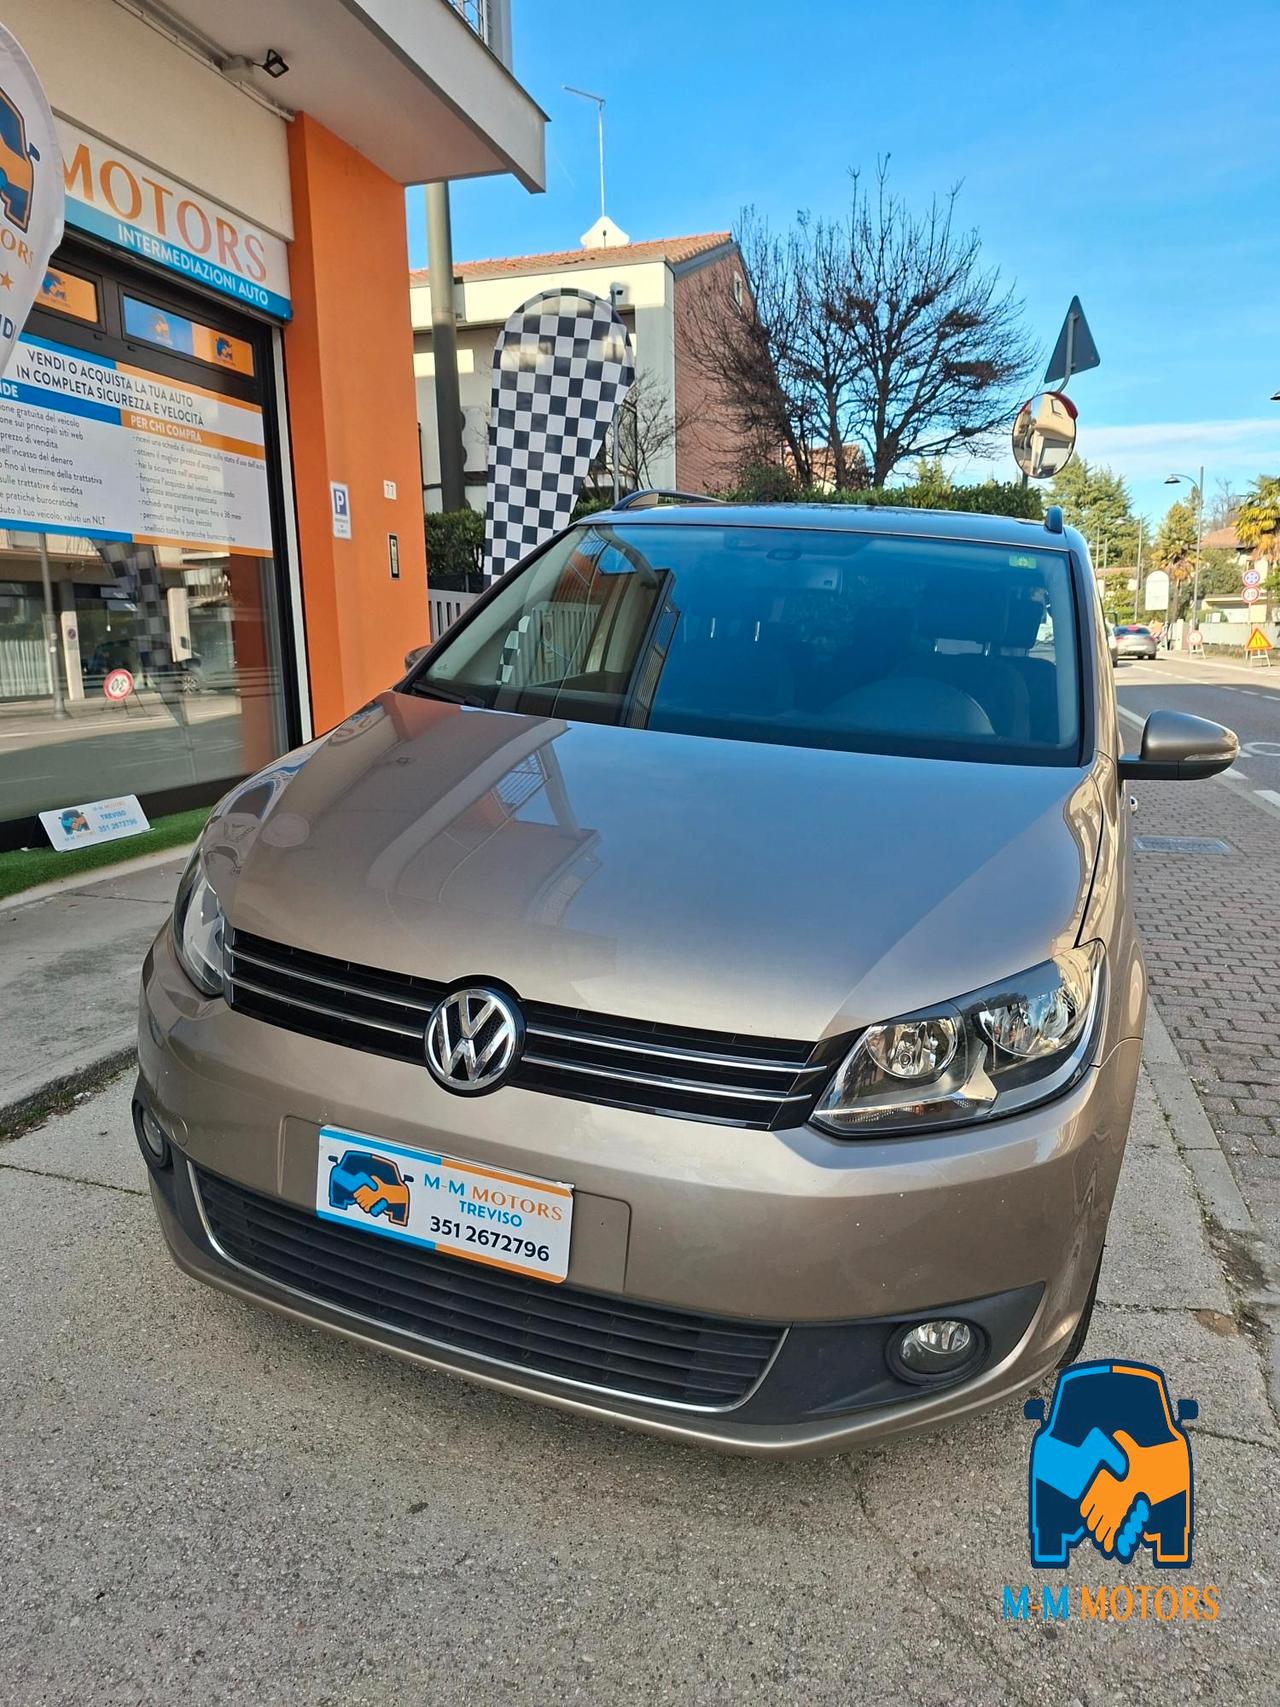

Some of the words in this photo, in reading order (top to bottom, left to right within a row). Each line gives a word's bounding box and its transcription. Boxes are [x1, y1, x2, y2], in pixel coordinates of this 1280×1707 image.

[63, 143, 267, 283] MOTORS
[118, 224, 236, 292] INTERMEDIAZIONI
[238, 280, 269, 305] AUTO
[16, 364, 30, 380] IN
[33, 370, 95, 397] COMPLETA
[97, 386, 152, 413] SICUREZZA
[153, 402, 160, 415] E
[27, 349, 66, 372] VENDI
[68, 361, 78, 375] O
[80, 366, 133, 391] ACQUISTA
[135, 380, 147, 396] LA
[148, 384, 168, 401] TUA
[169, 391, 193, 408] AUTO
[16, 408, 44, 419] gratuita
[45, 412, 56, 423] del
[57, 416, 80, 428] veicolo
[26, 422, 58, 436] principali
[71, 431, 84, 441] web
[130, 415, 149, 431] PER
[149, 419, 166, 434] CHI
[166, 424, 202, 443] COMPRA
[0, 431, 23, 442] prezzo
[25, 434, 32, 444] di
[33, 438, 59, 449] vendita
[4, 459, 19, 471] fino
[20, 463, 27, 472] al
[28, 465, 55, 477] termine
[56, 469, 73, 480] della
[73, 472, 103, 485] trattativa
[38, 451, 49, 461] del
[50, 454, 74, 466] denaro
[5, 490, 36, 502] pratiche
[36, 493, 79, 509] burocratiche
[17, 478, 50, 490] trattative
[59, 485, 83, 496] vendita
[424, 1173, 465, 1197] M-M
[472, 1185, 564, 1222] MOTORS
[459, 1199, 523, 1229] TREVISO
[429, 1215, 461, 1240] 351
[466, 1225, 551, 1263] 2672796
